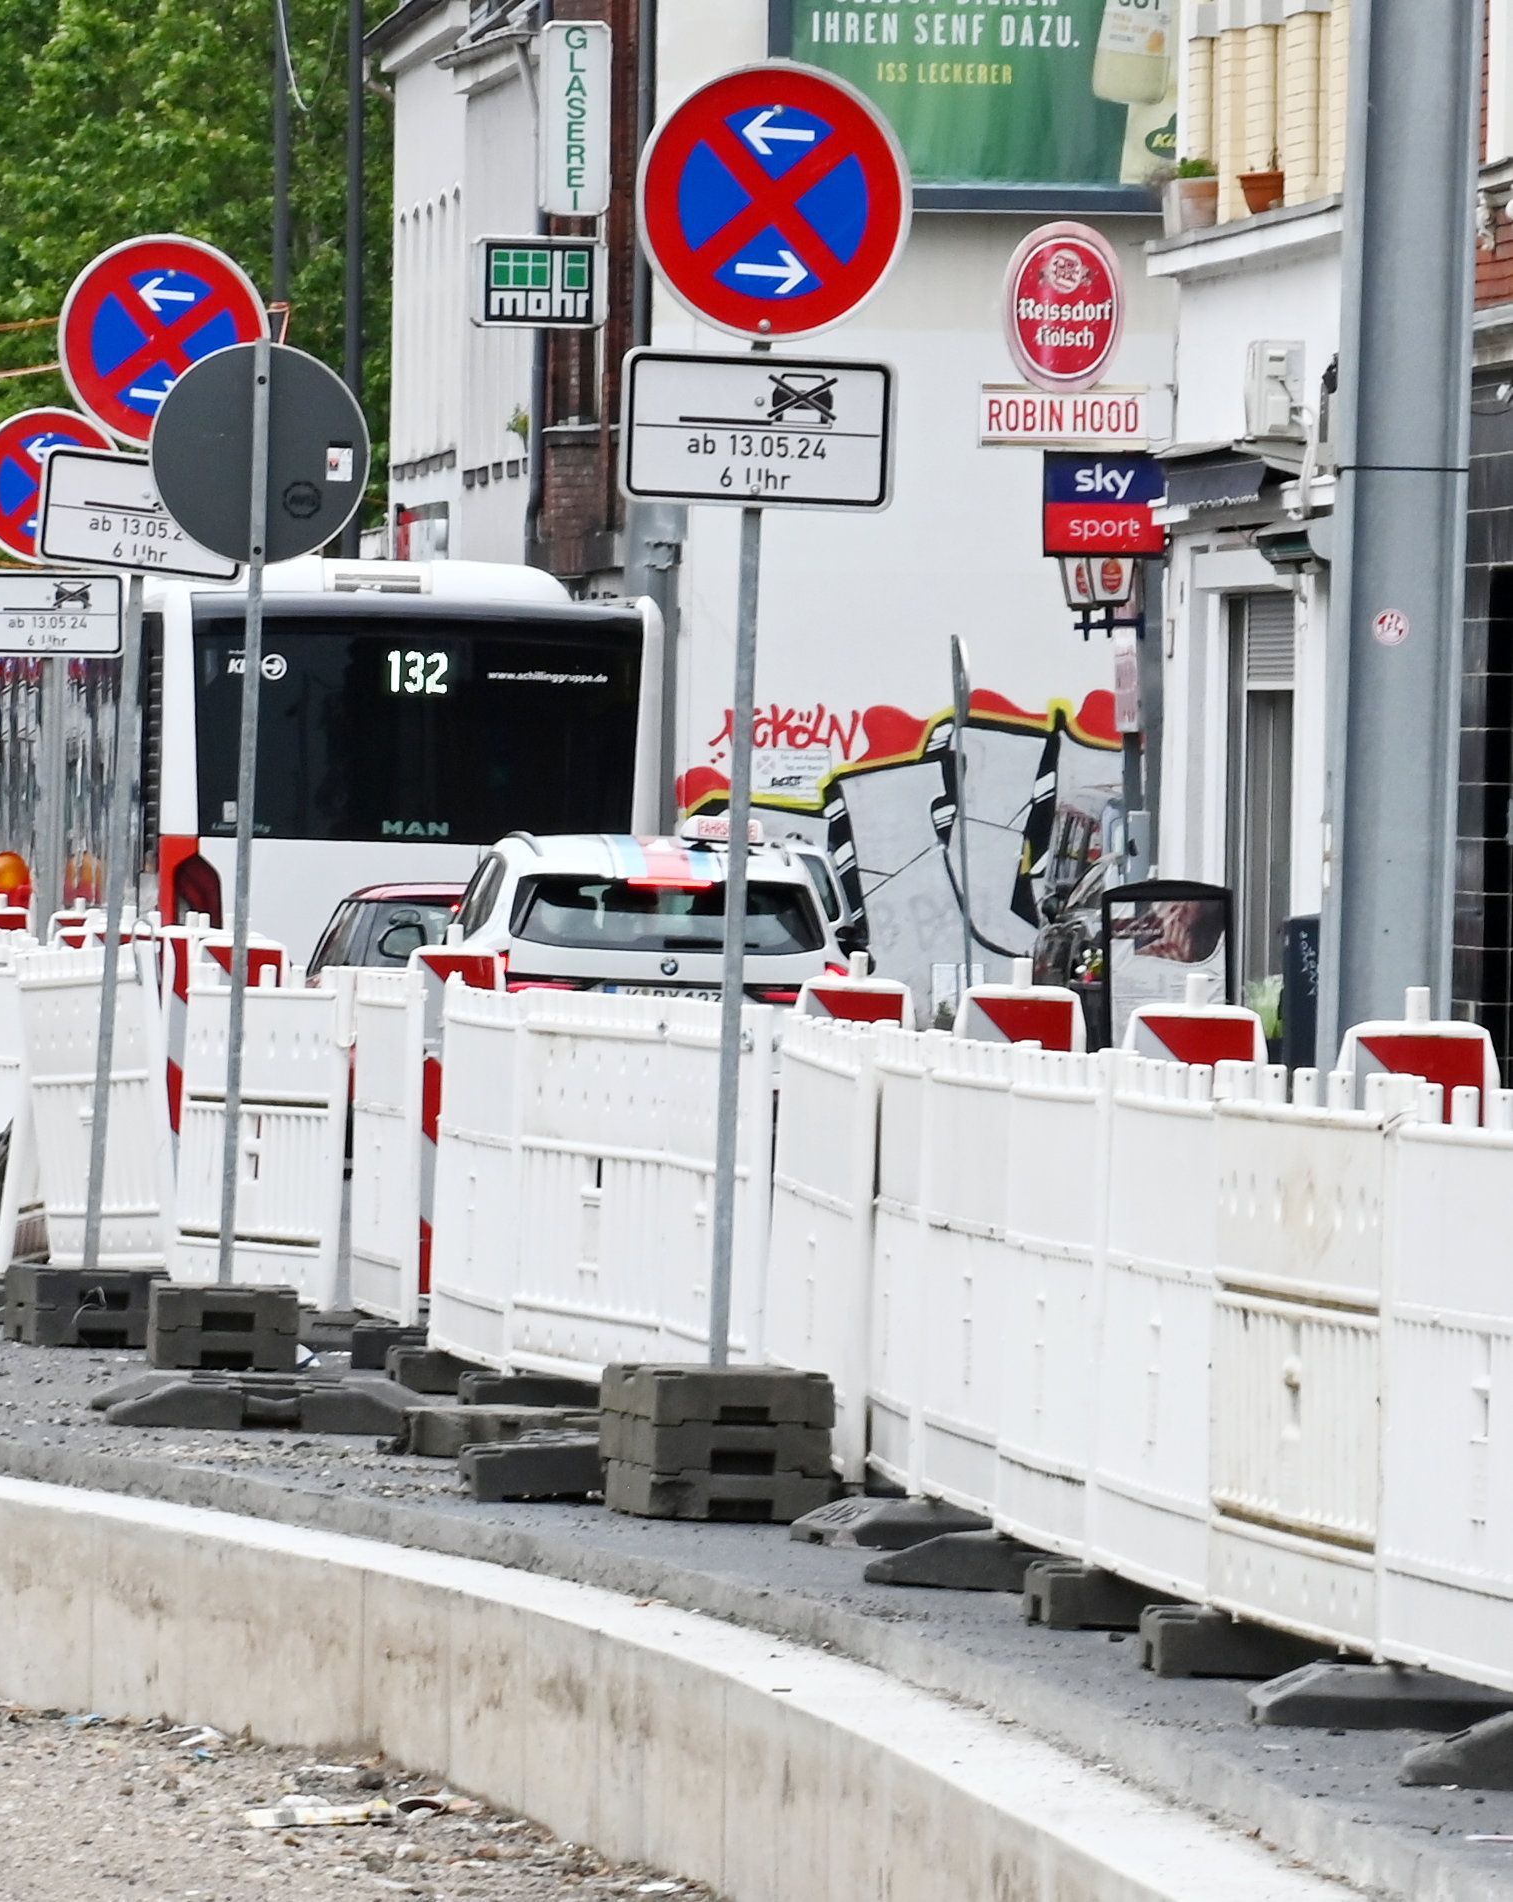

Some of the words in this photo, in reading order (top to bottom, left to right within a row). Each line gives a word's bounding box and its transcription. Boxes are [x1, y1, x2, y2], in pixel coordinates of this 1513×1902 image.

[812, 11, 898, 44] IHREN
[914, 13, 985, 45] SENF
[1000, 14, 1080, 47] DAZU.
[877, 62, 907, 82] ISS
[918, 63, 1013, 84] LECKERER
[565, 26, 587, 211] GLASEREI
[1017, 298, 1112, 321] Reissdorf
[1035, 325, 1095, 350] Kölsch
[988, 399, 1064, 432] ROBIN
[1073, 399, 1139, 433] HOOD
[687, 433, 716, 454] ab
[729, 434, 827, 460] 13.05.24
[720, 466, 732, 487] 6
[745, 467, 791, 490] Uhr
[1074, 462, 1135, 500] sky
[89, 516, 112, 533] ab
[121, 518, 183, 542] 13.05.2
[1069, 518, 1141, 541] sport
[113, 542, 123, 558] 6
[133, 544, 168, 563] Uhr
[8, 616, 25, 629] ab
[32, 616, 88, 630] 13.05.24
[27, 634, 35, 646] 6
[387, 650, 448, 694] 132
[381, 819, 449, 836] MAN
